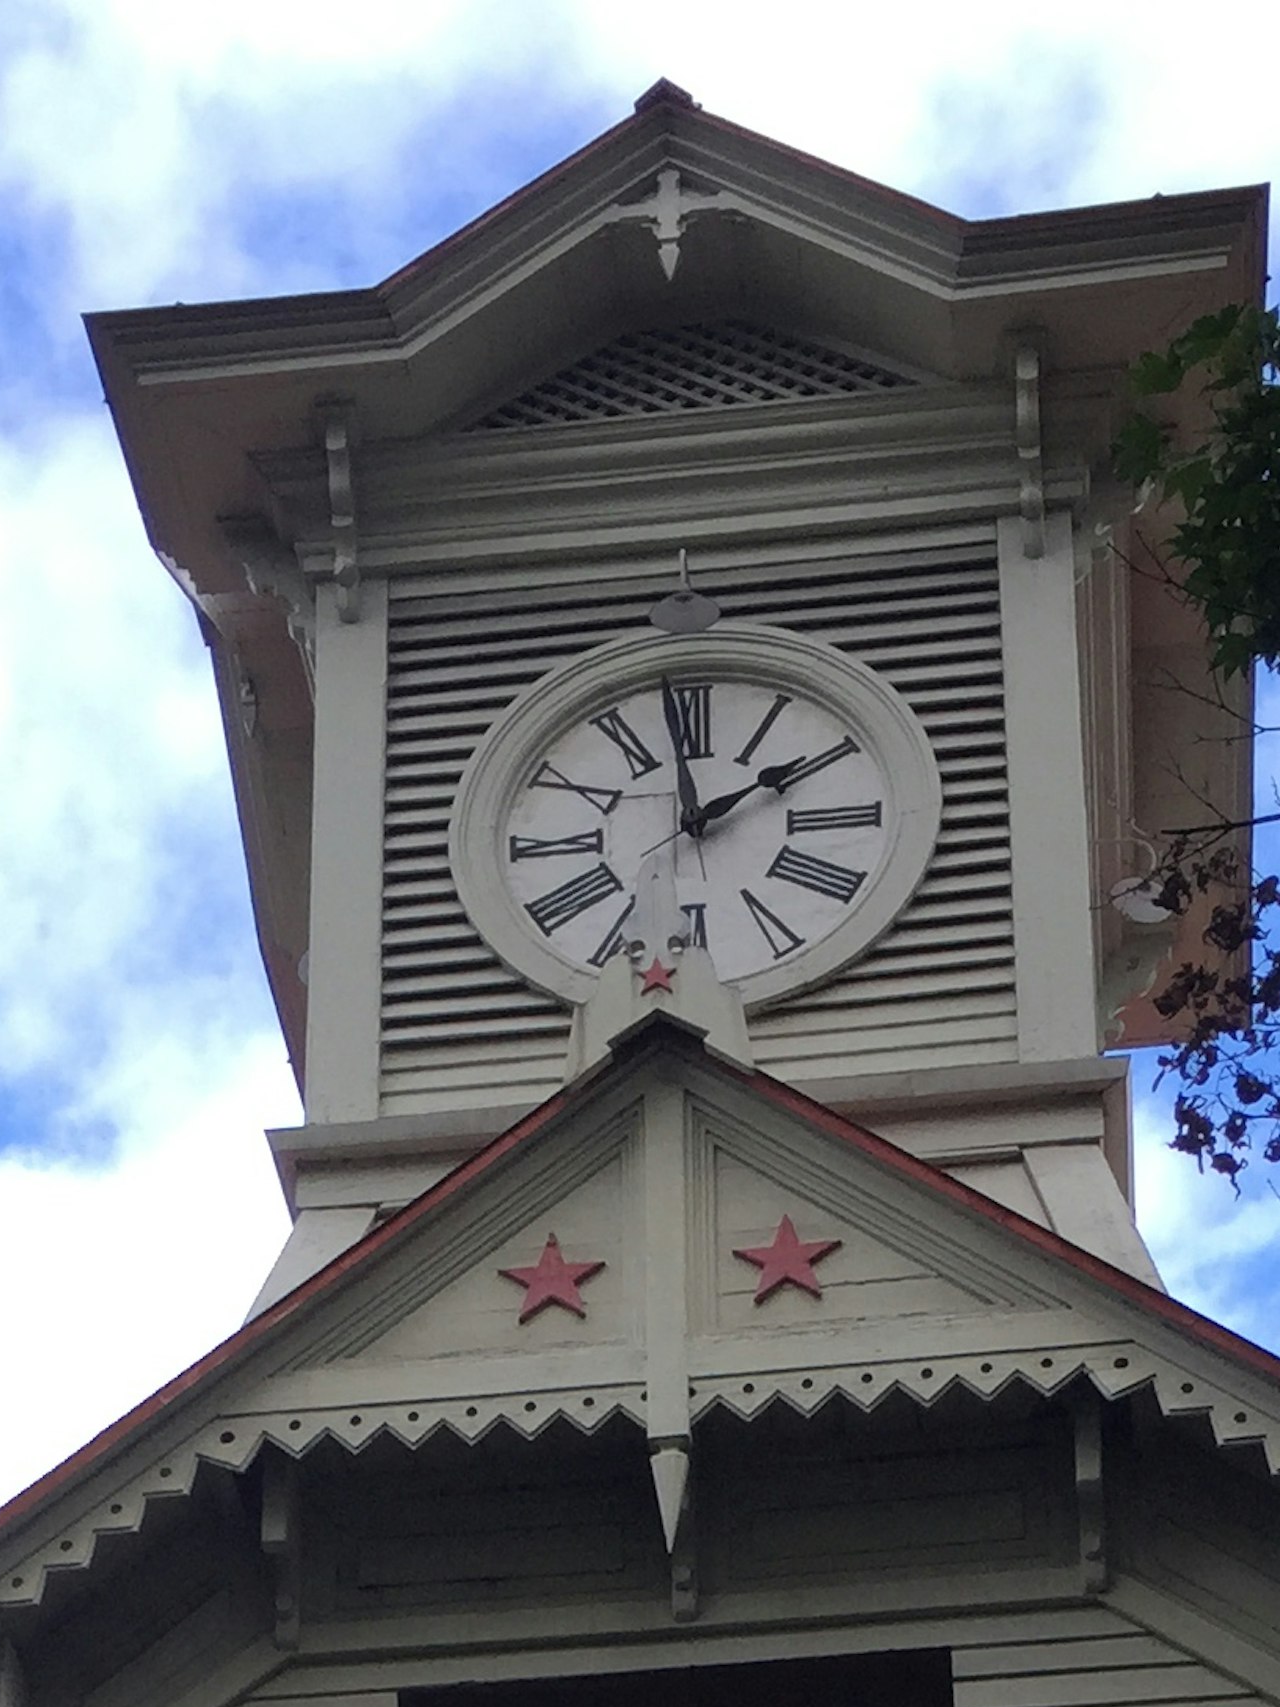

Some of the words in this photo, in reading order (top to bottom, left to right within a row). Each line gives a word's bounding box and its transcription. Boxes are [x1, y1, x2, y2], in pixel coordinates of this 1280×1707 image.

[589, 707, 663, 780] XI
[673, 685, 714, 759] XII
[734, 694, 792, 766] I
[528, 760, 623, 815] X
[776, 735, 861, 797] II
[510, 829, 603, 862] IX
[787, 801, 882, 837] III
[524, 862, 624, 937] VIII
[739, 888, 807, 960] V
